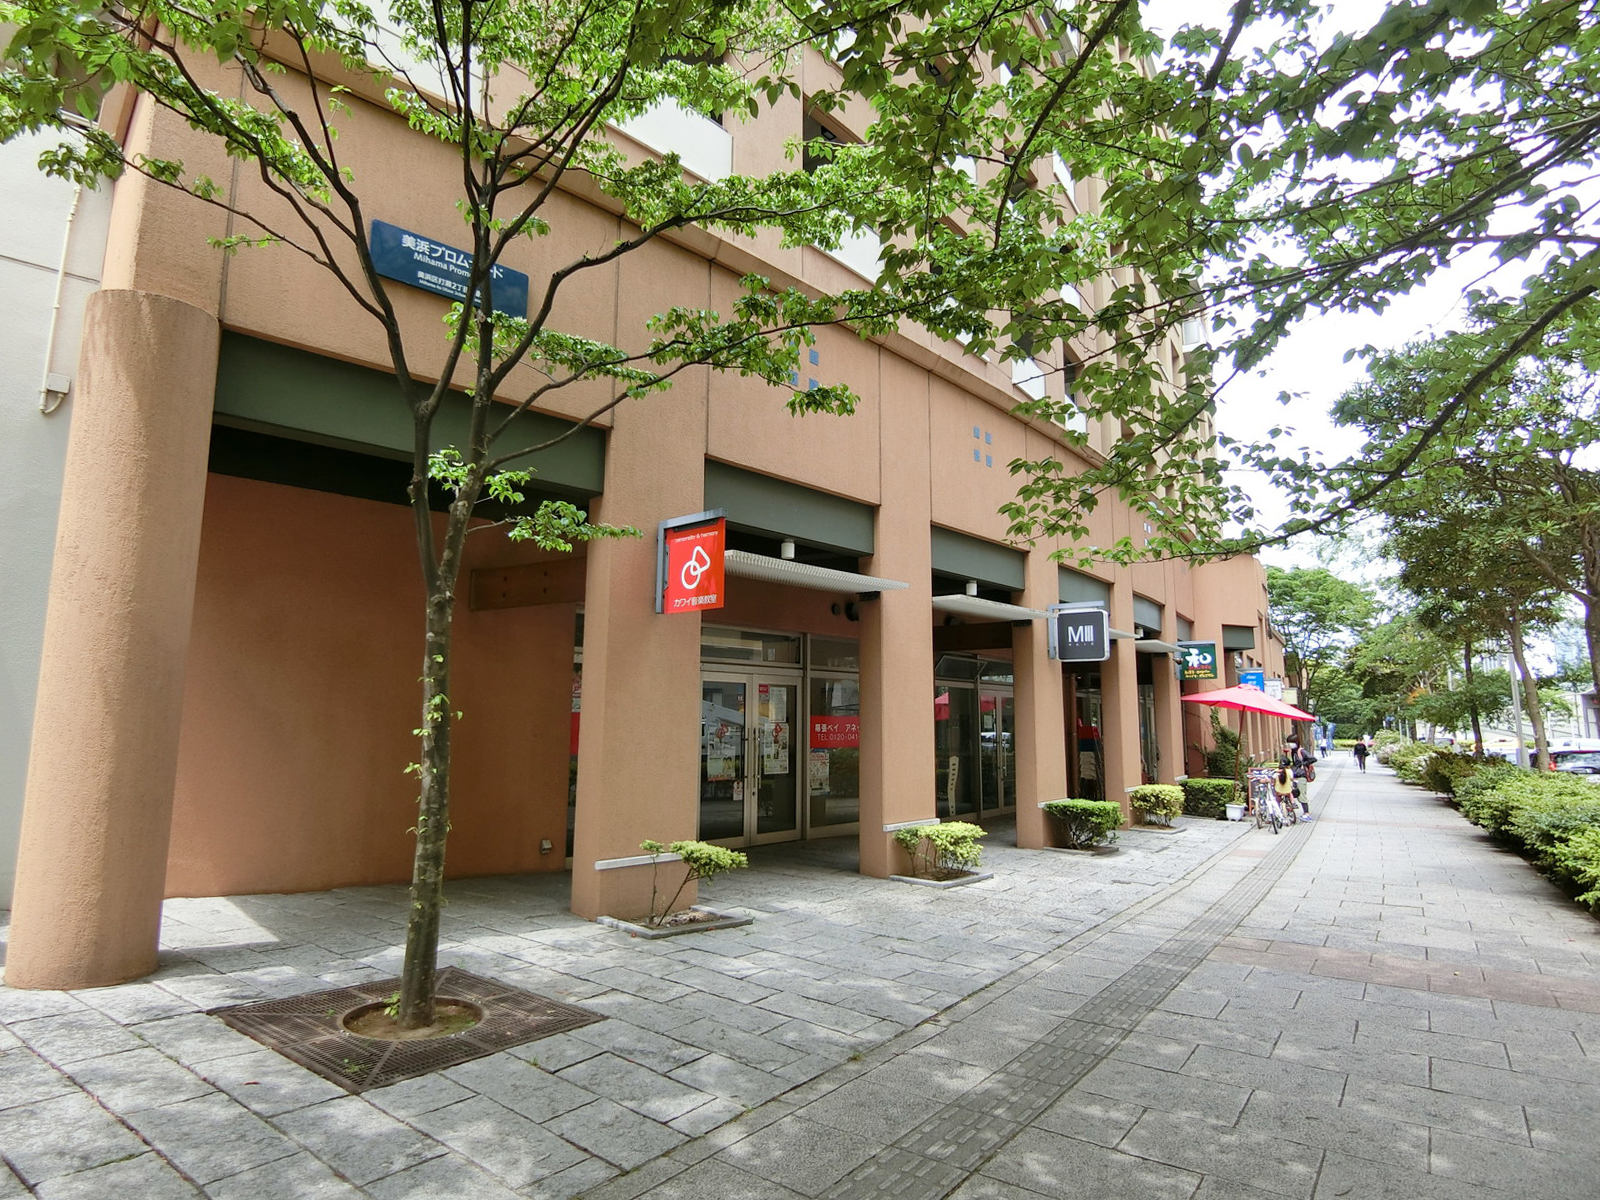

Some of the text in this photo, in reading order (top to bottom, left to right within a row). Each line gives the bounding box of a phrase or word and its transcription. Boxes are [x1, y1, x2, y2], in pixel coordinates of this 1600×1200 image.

[402, 234, 503, 279] 美浜プロムド
[413, 252, 448, 270] Mihama
[817, 733, 828, 741] TEL
